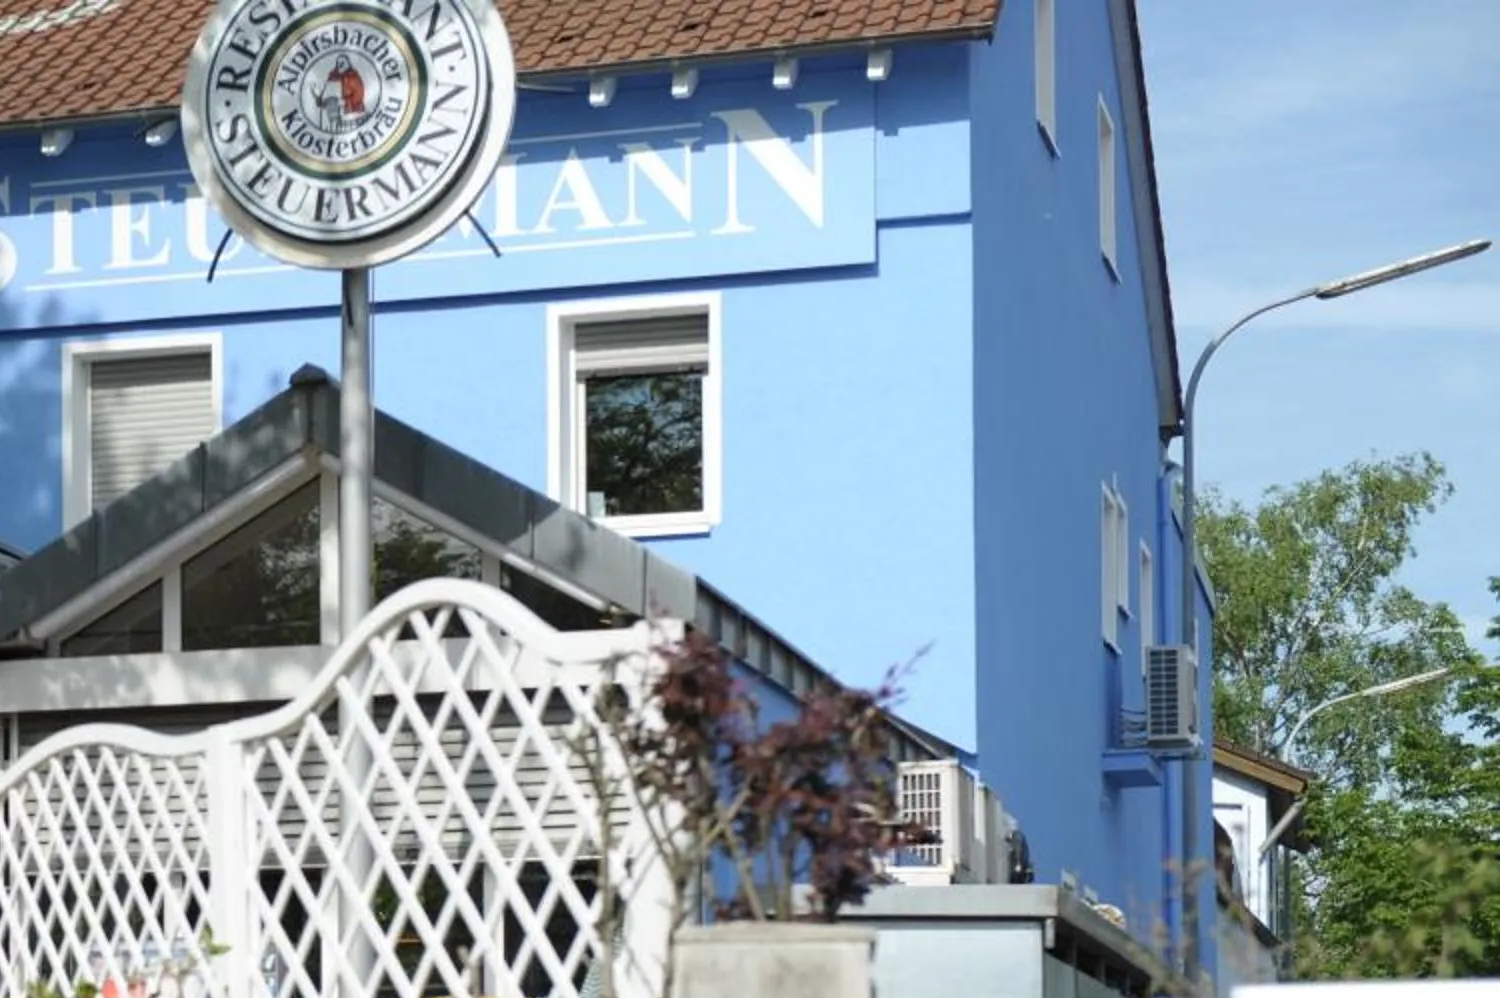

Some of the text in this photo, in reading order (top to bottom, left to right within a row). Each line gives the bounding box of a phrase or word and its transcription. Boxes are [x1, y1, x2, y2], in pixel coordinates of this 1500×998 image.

[278, 26, 402, 96] Alpirsbacher
[216, 80, 469, 225] STEUERMANN
[282, 97, 402, 157] Klosterbräu
